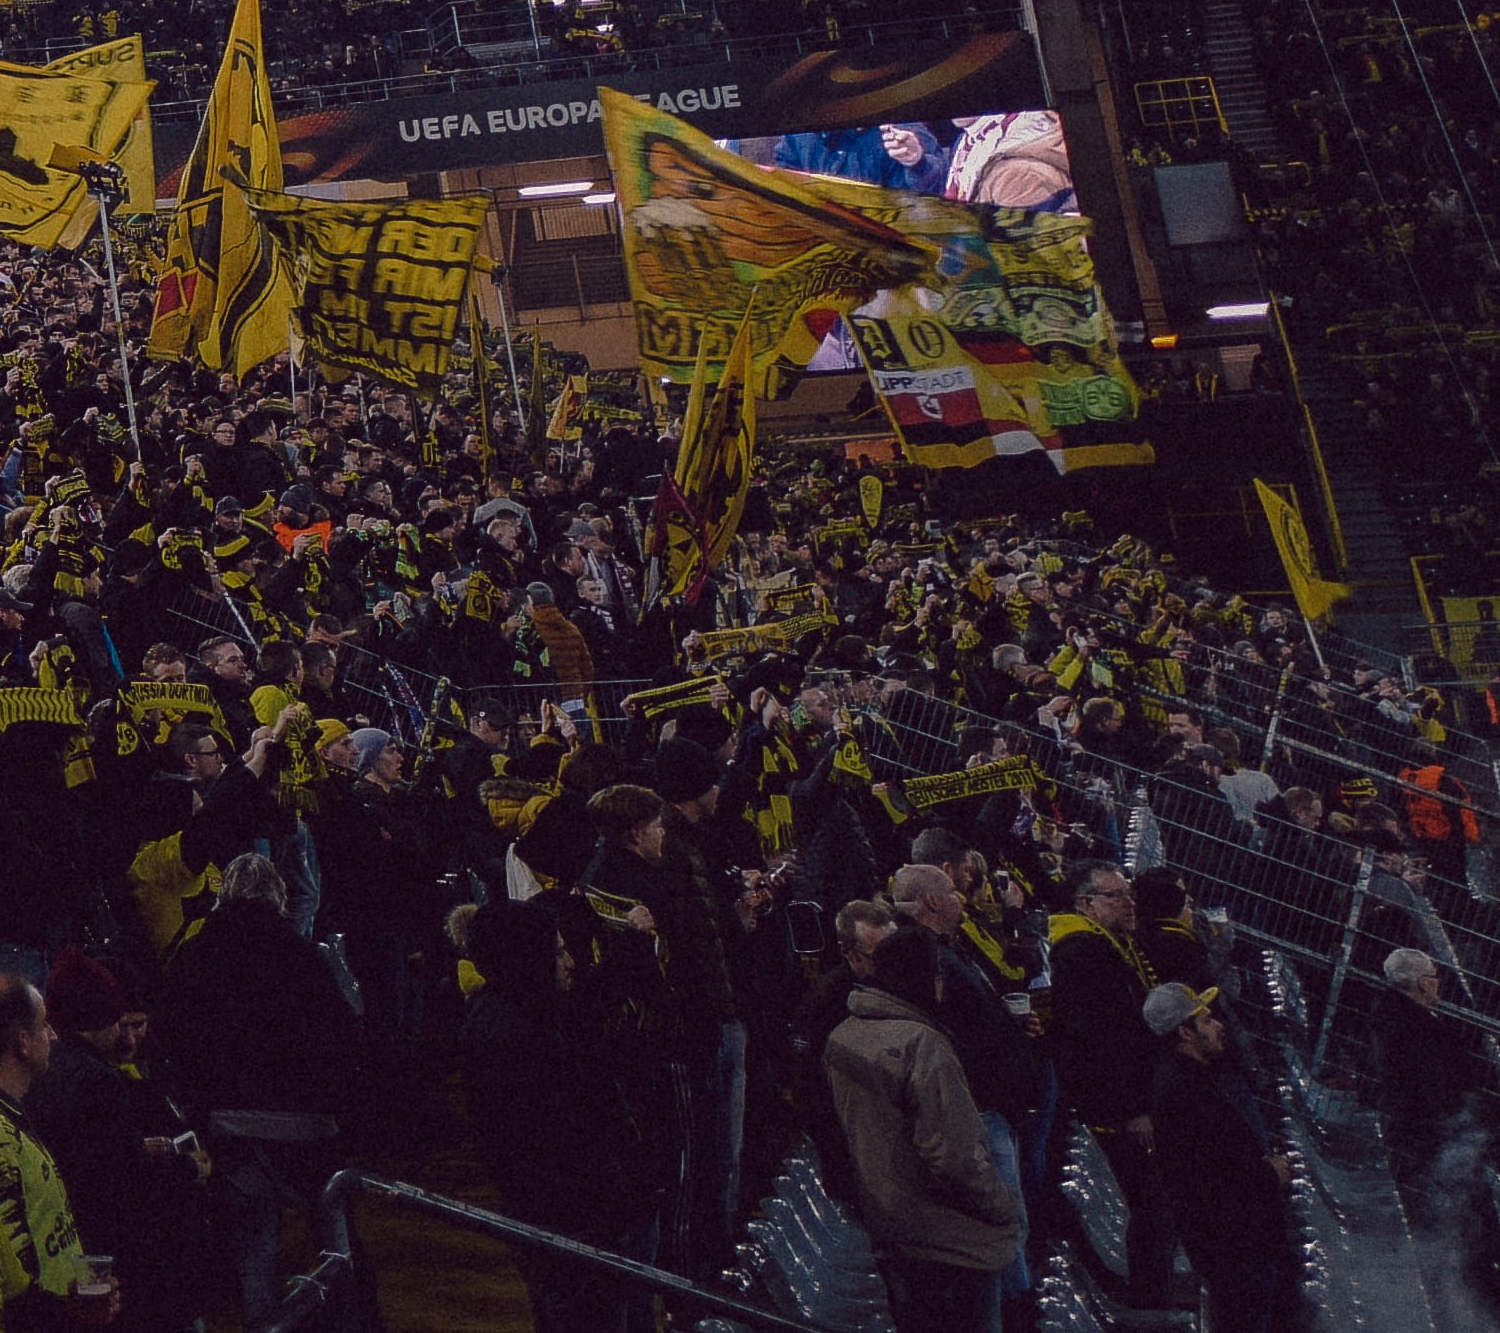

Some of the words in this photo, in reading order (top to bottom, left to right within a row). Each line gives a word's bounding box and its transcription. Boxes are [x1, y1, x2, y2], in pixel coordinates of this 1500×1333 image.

[398, 113, 483, 143] UEFA
[486, 100, 606, 135] EUROPA
[906, 780, 963, 807] DEUTSCHER
[963, 775, 1004, 799] MEISTER
